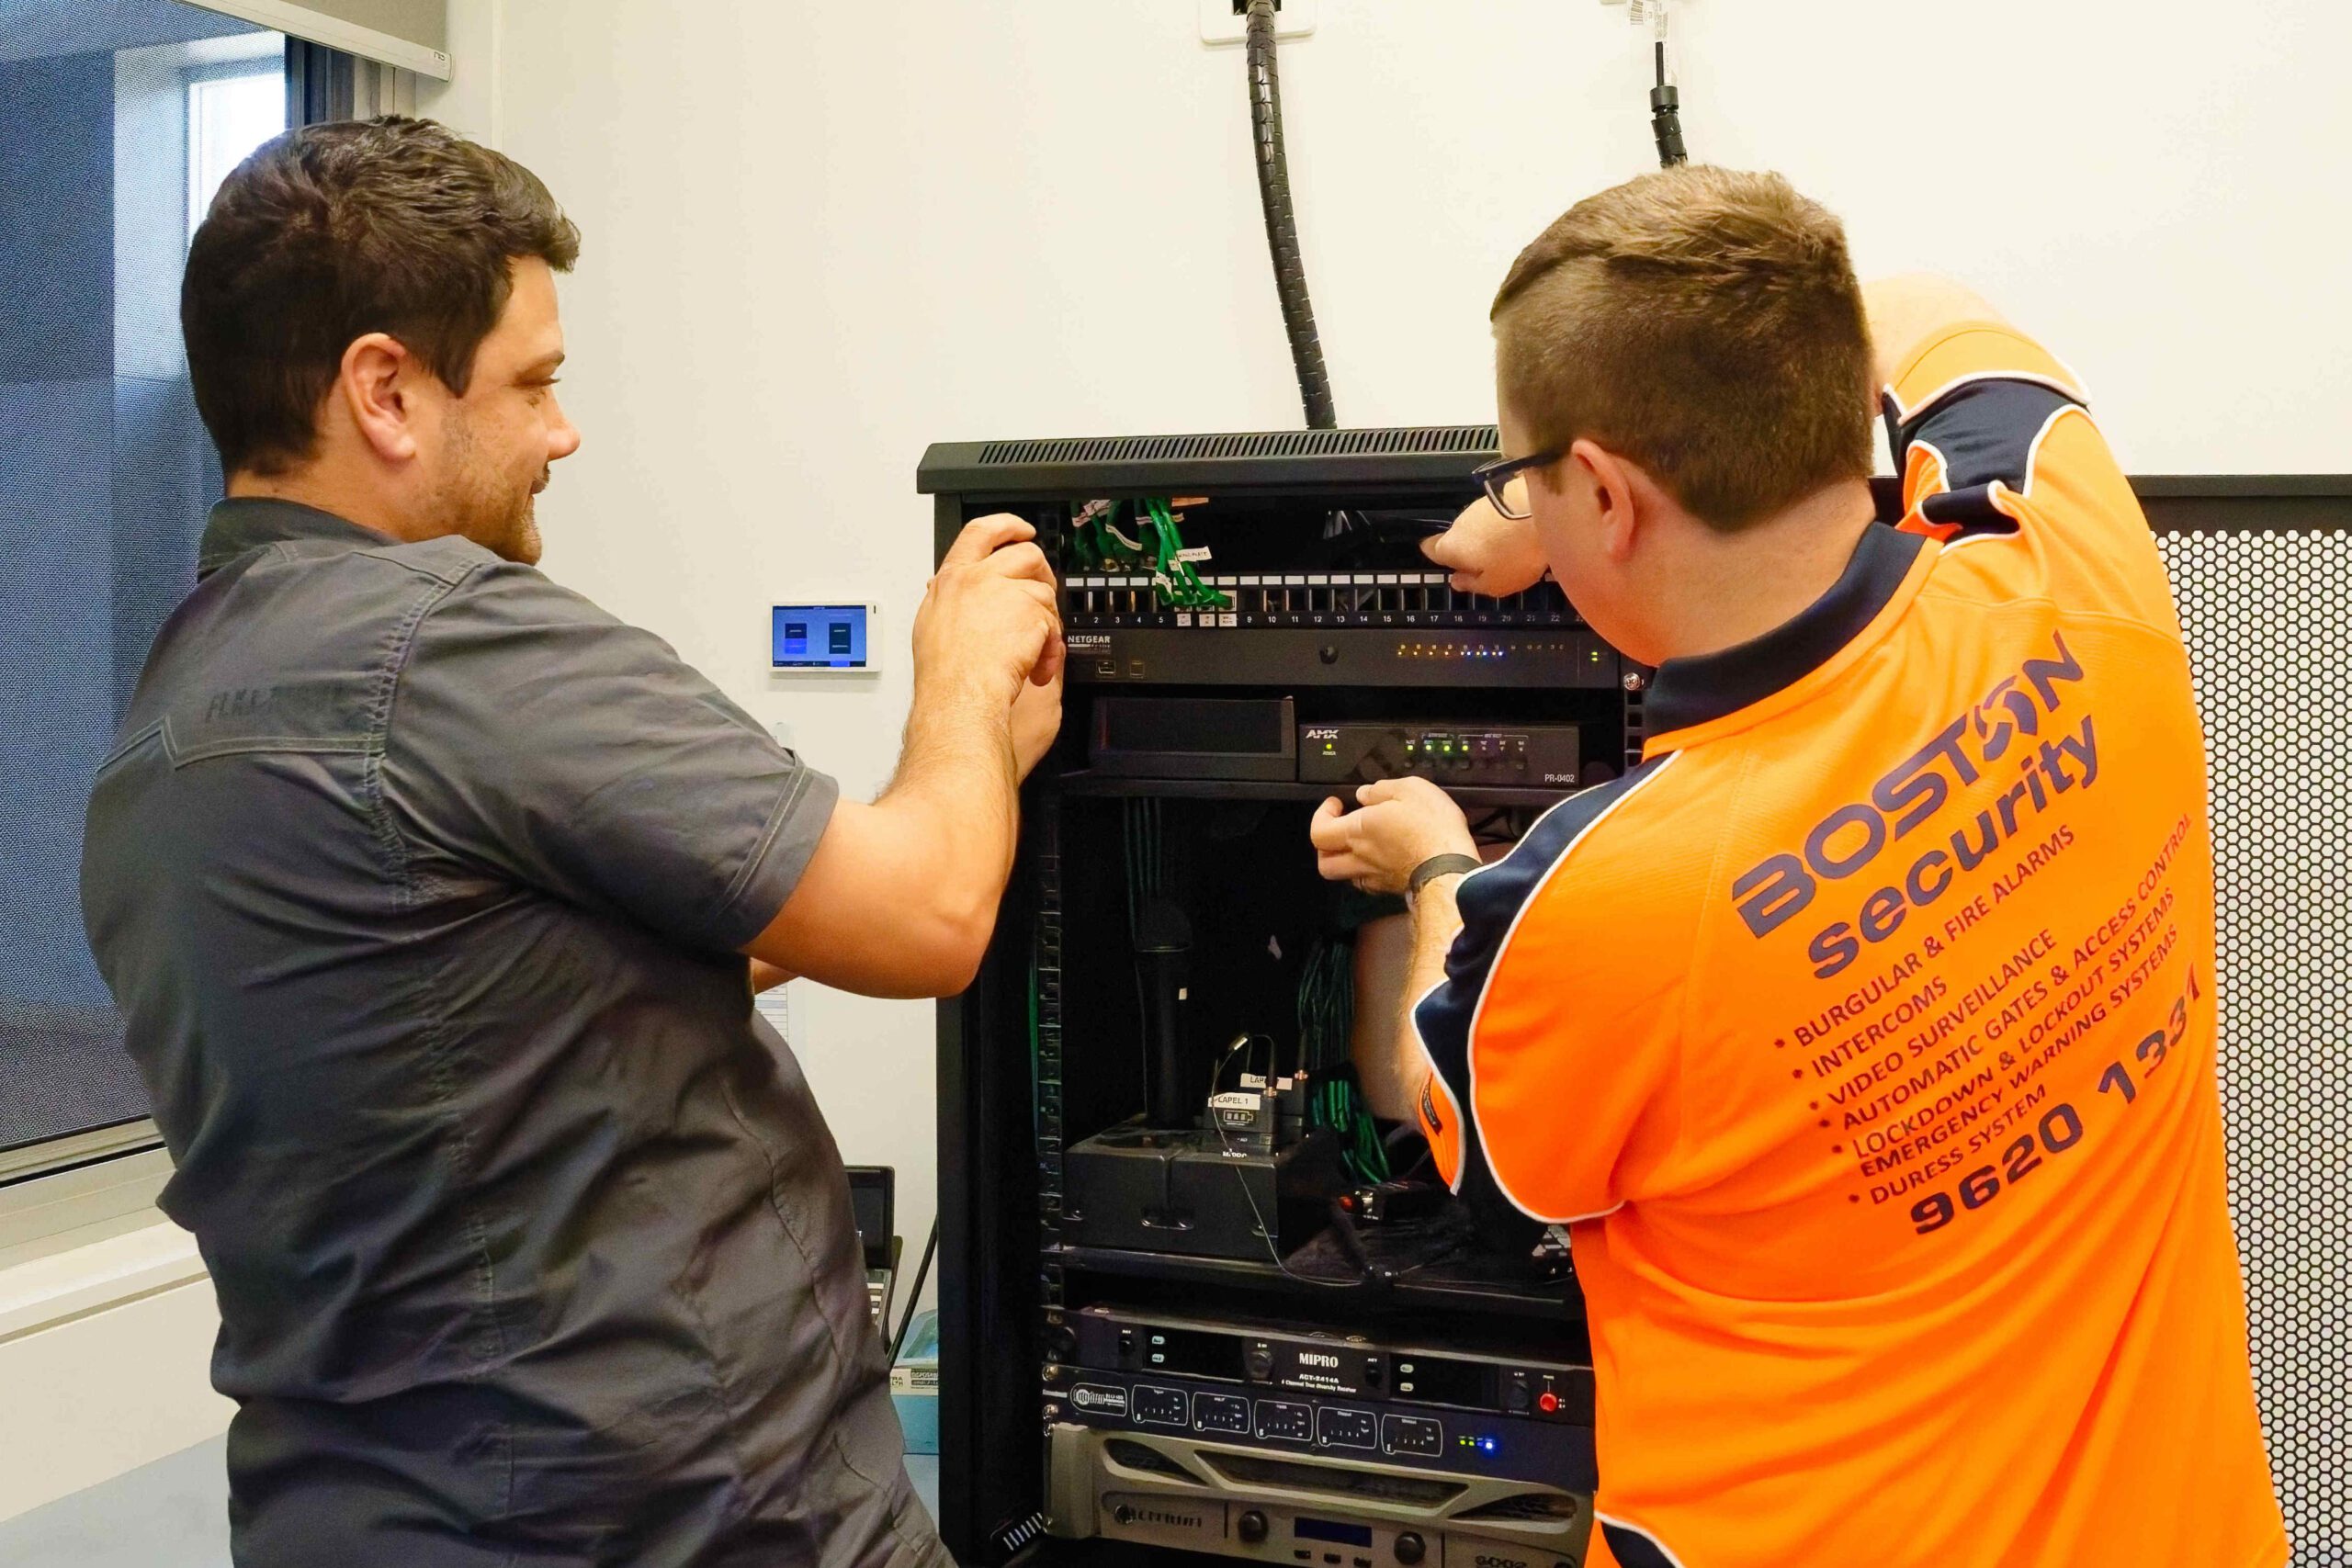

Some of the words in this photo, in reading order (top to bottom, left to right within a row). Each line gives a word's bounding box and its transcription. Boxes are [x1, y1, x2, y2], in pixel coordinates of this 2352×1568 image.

[1306, 729, 1339, 739] AMX
[1544, 774, 1575, 783] PR-0402
[1732, 629, 2084, 939] BOSTON
[1793, 952, 1923, 1047] BURGULAR
[1923, 935, 1945, 959] &
[1944, 895, 1991, 942] FIRE
[1992, 824, 2075, 905] ALARMS
[1808, 715, 2098, 979] security
[1812, 976, 1948, 1077] INTERCOMS
[1827, 1052, 1904, 1106] VIDEO
[1907, 929, 2057, 1058] SURVEILLANCE
[1843, 1034, 1984, 1130] AUTOMATIC
[1984, 980, 2048, 1040] GATES
[2050, 964, 2070, 987] &
[2073, 897, 2137, 970] ACCESS
[2137, 813, 2192, 901] CONTROL
[1852, 1066, 1994, 1159] LOCKDOWN
[1998, 1050, 2017, 1071] &
[2018, 965, 2104, 1055] LOCKOUT
[2109, 886, 2174, 973] SYSTEMS
[1860, 1088, 2003, 1178] EMERGENCY
[2009, 1002, 2107, 1089] WARNING
[2109, 923, 2177, 1009] SYSTEMS
[1870, 1146, 1964, 1205] DURESS
[1967, 1084, 2047, 1155] SYSTEM
[1910, 1102, 2084, 1235] 9620
[2097, 962, 2200, 1104] 1331
[1299, 1352, 1339, 1368] MIPRO
